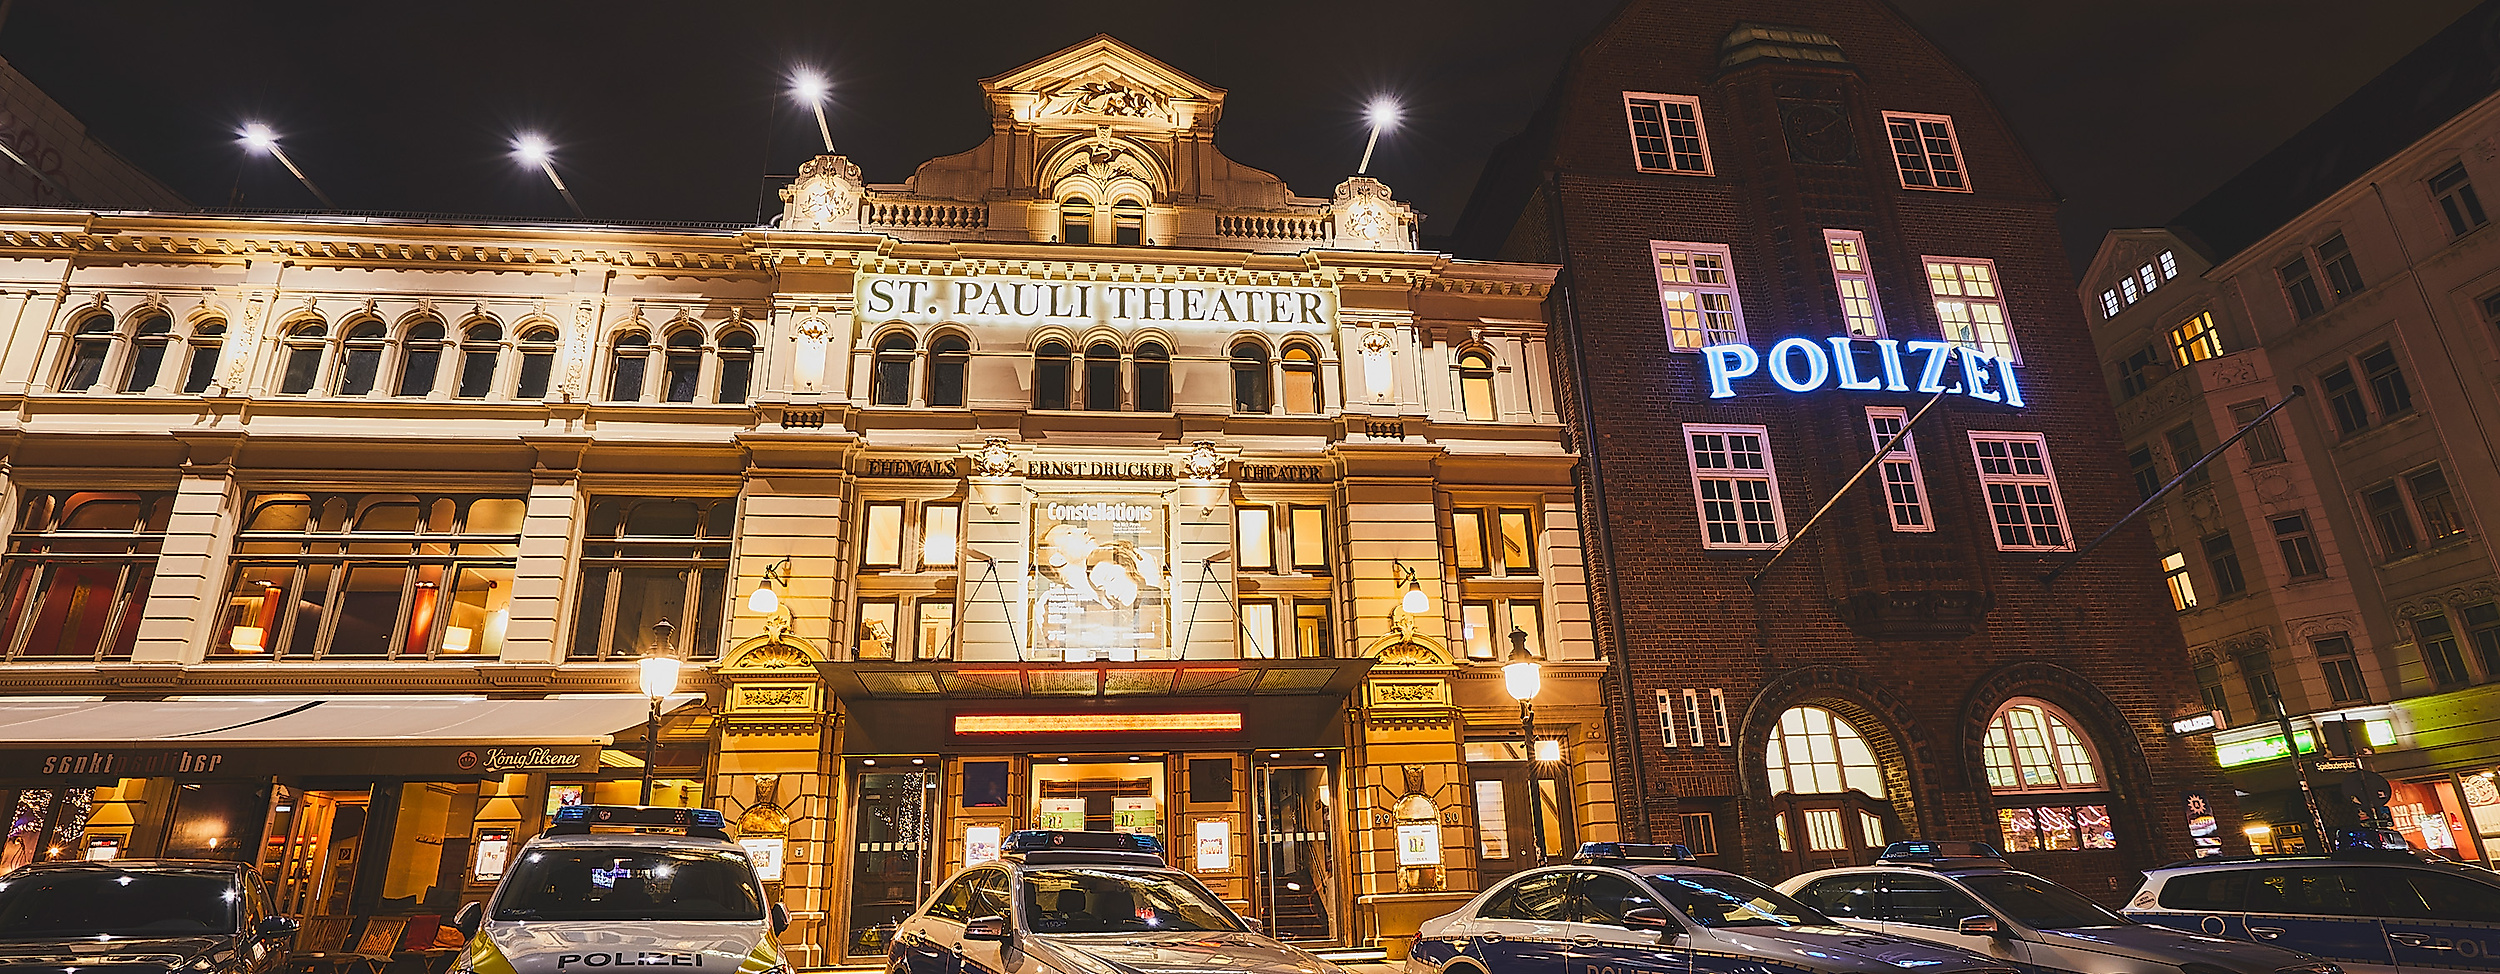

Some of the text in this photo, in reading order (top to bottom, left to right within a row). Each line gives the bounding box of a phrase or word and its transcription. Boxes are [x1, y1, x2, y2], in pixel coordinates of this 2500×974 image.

[868, 279, 1327, 325] ST. PAULI THEATER
[1701, 336, 2026, 408] POLIZEI
[867, 459, 957, 477] EHEMALS
[1027, 460, 1174, 479] ERNST DRUCKER
[1239, 464, 1322, 482] THEATER
[1047, 502, 1153, 521] Constellations
[483, 747, 580, 769] König Pilsener
[1374, 813, 1390, 824] 29
[1444, 812, 1459, 823] 30
[557, 952, 703, 969] POLIZEI
